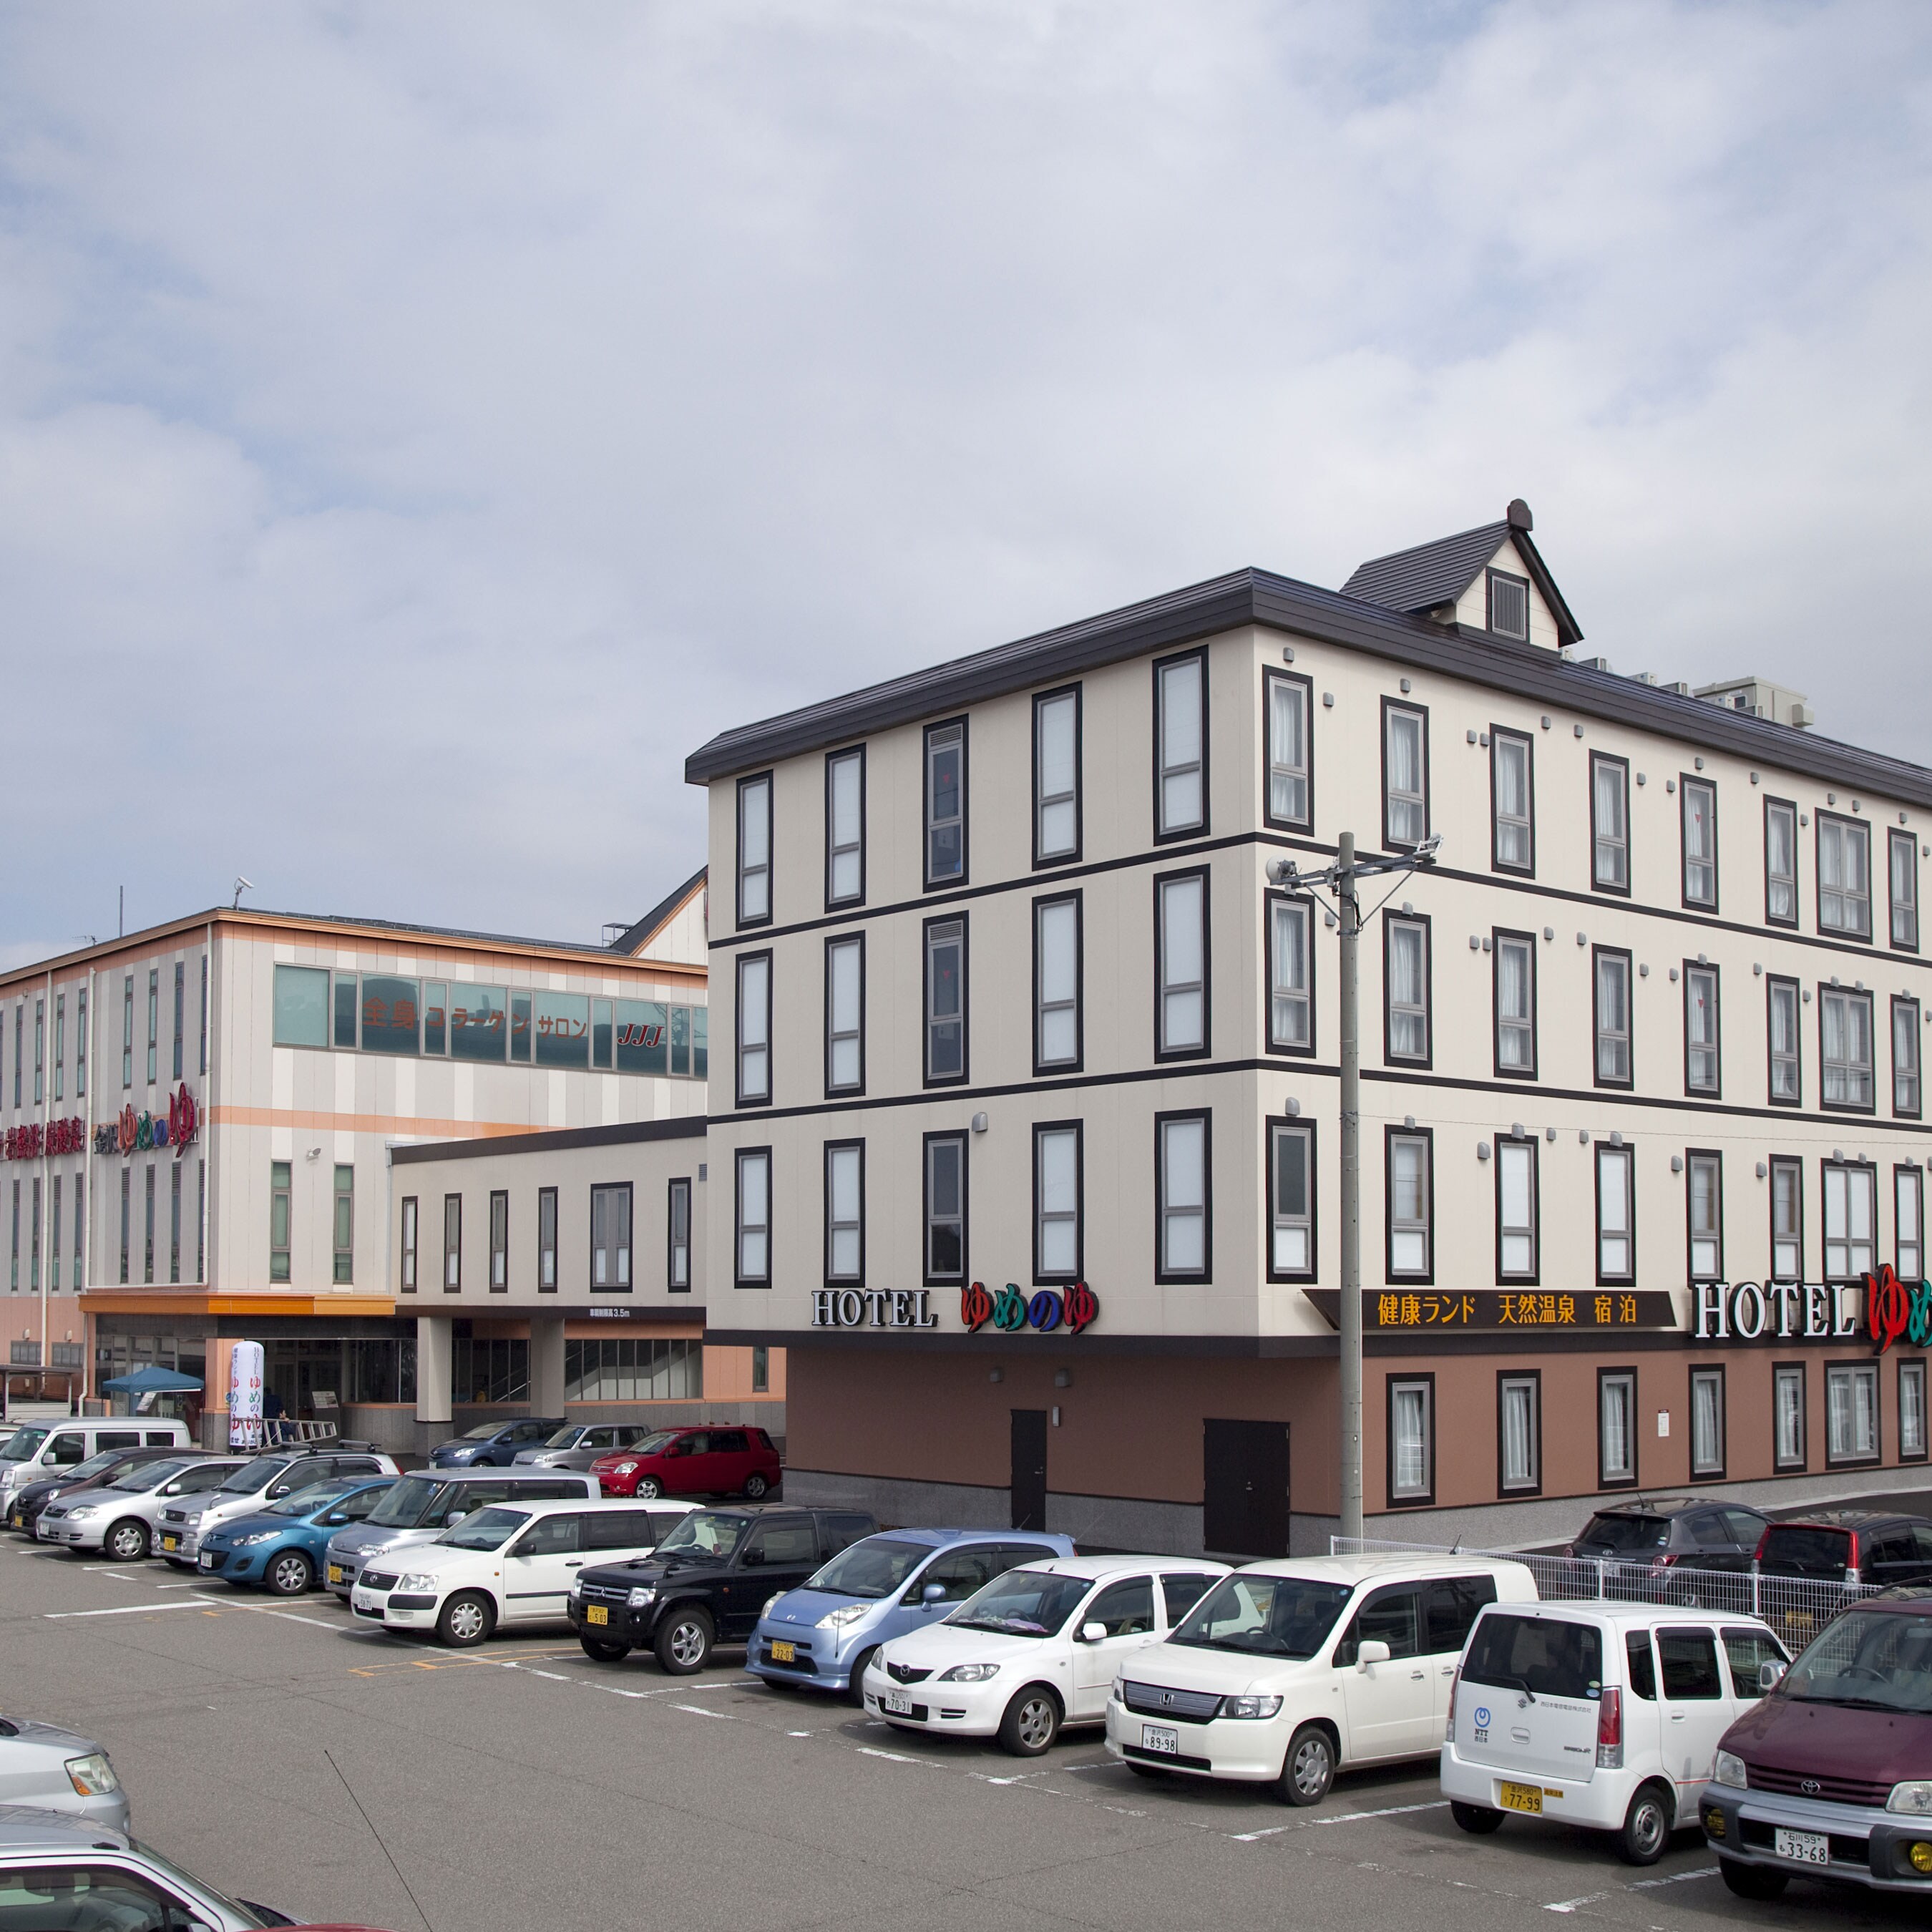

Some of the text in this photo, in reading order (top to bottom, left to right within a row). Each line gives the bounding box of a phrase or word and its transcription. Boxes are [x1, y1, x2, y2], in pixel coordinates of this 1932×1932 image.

[618, 1022, 664, 1048] JJJ
[811, 1281, 1100, 1335] HOTEL ゆめのゆ
[1378, 1294, 1637, 1325] 健康ランド 天然温泉 宿泊
[1692, 1281, 1855, 1339] HOTEL
[776, 1649, 794, 1660] 22-03
[891, 1698, 909, 1712] 70-31
[1475, 1728, 1488, 1737] NTT
[1150, 1736, 1175, 1752] 89-98
[1510, 1793, 1541, 1812] 77-99
[1788, 1832, 1816, 1844] 石川59
[1787, 1842, 1826, 1863] 33-68
